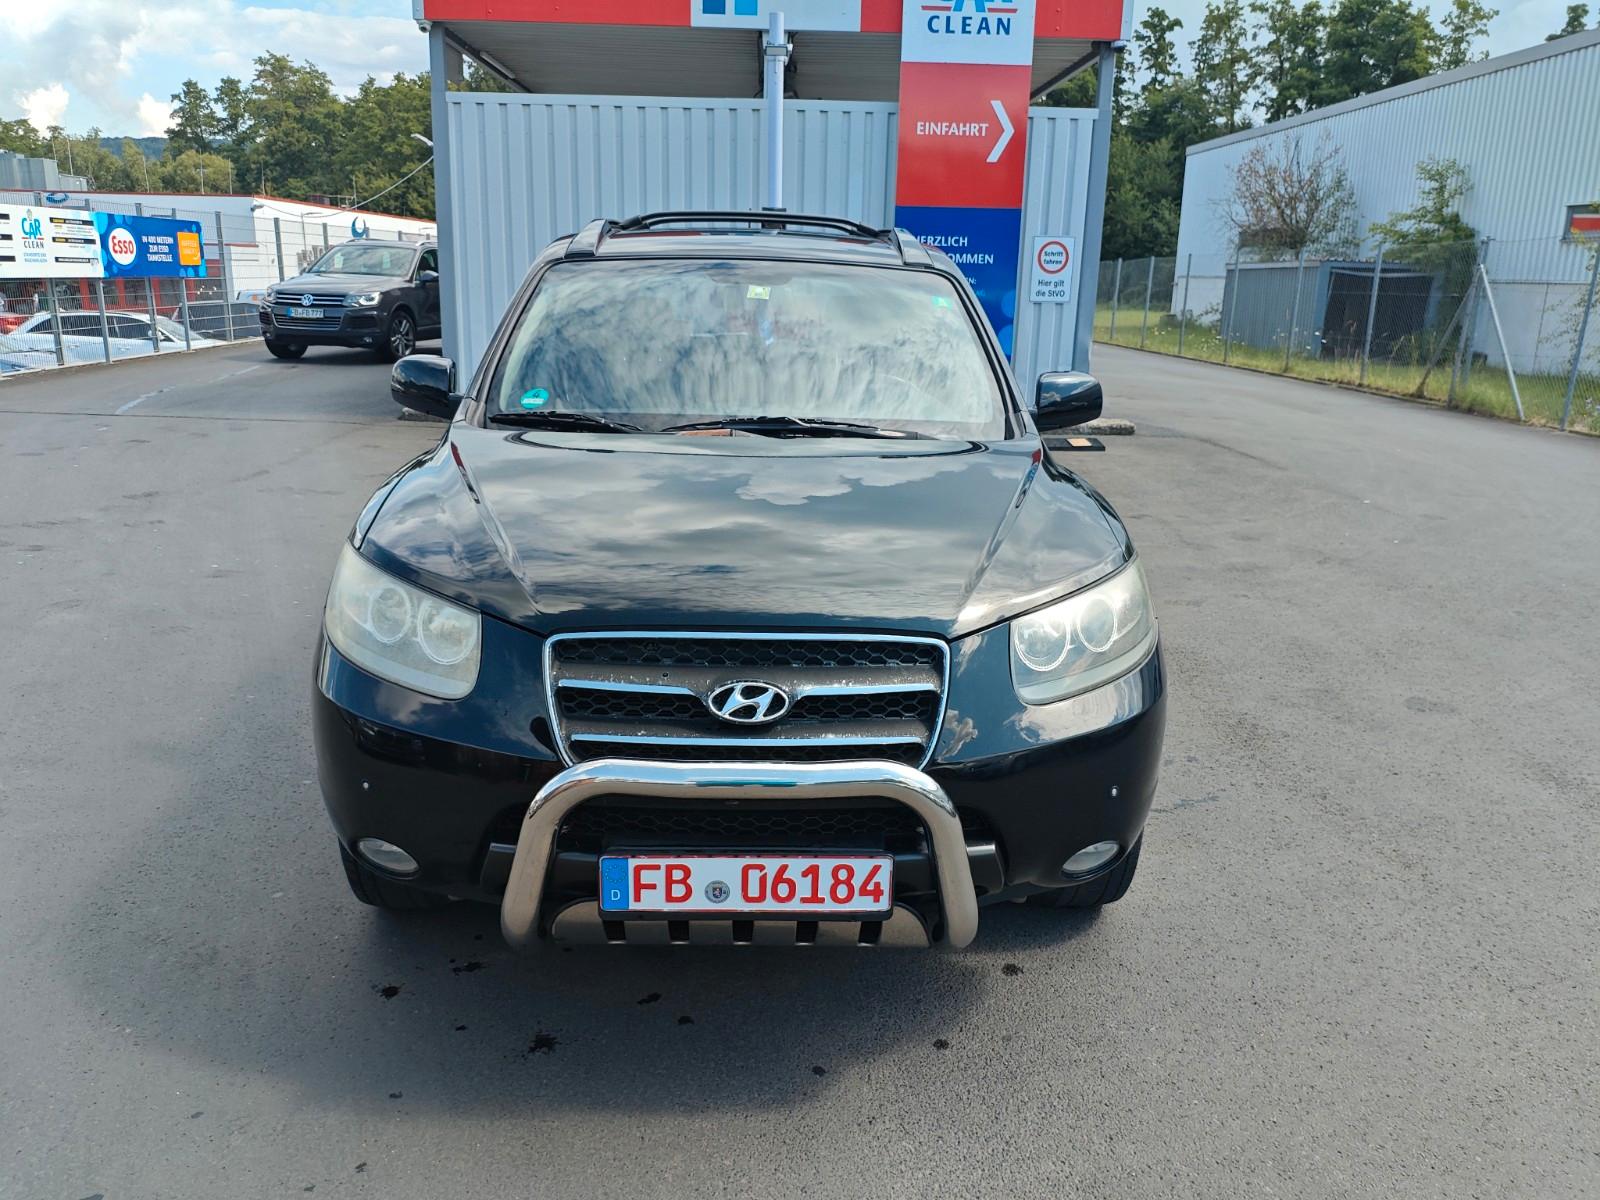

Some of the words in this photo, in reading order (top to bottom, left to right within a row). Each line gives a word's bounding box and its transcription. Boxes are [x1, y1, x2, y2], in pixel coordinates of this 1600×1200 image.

[927, 15, 1011, 35] CLEAN
[916, 122, 989, 137] EINFAHRT
[21, 217, 42, 240] CAR
[23, 240, 45, 249] CLEAN
[948, 253, 994, 265] OMMEN
[1038, 279, 1052, 287] Hier
[1053, 280, 1065, 288] gilt
[1035, 289, 1046, 297] die
[1047, 289, 1065, 298] StVO
[611, 889, 621, 901] D
[632, 863, 693, 903] FB
[741, 863, 884, 904] 06184
